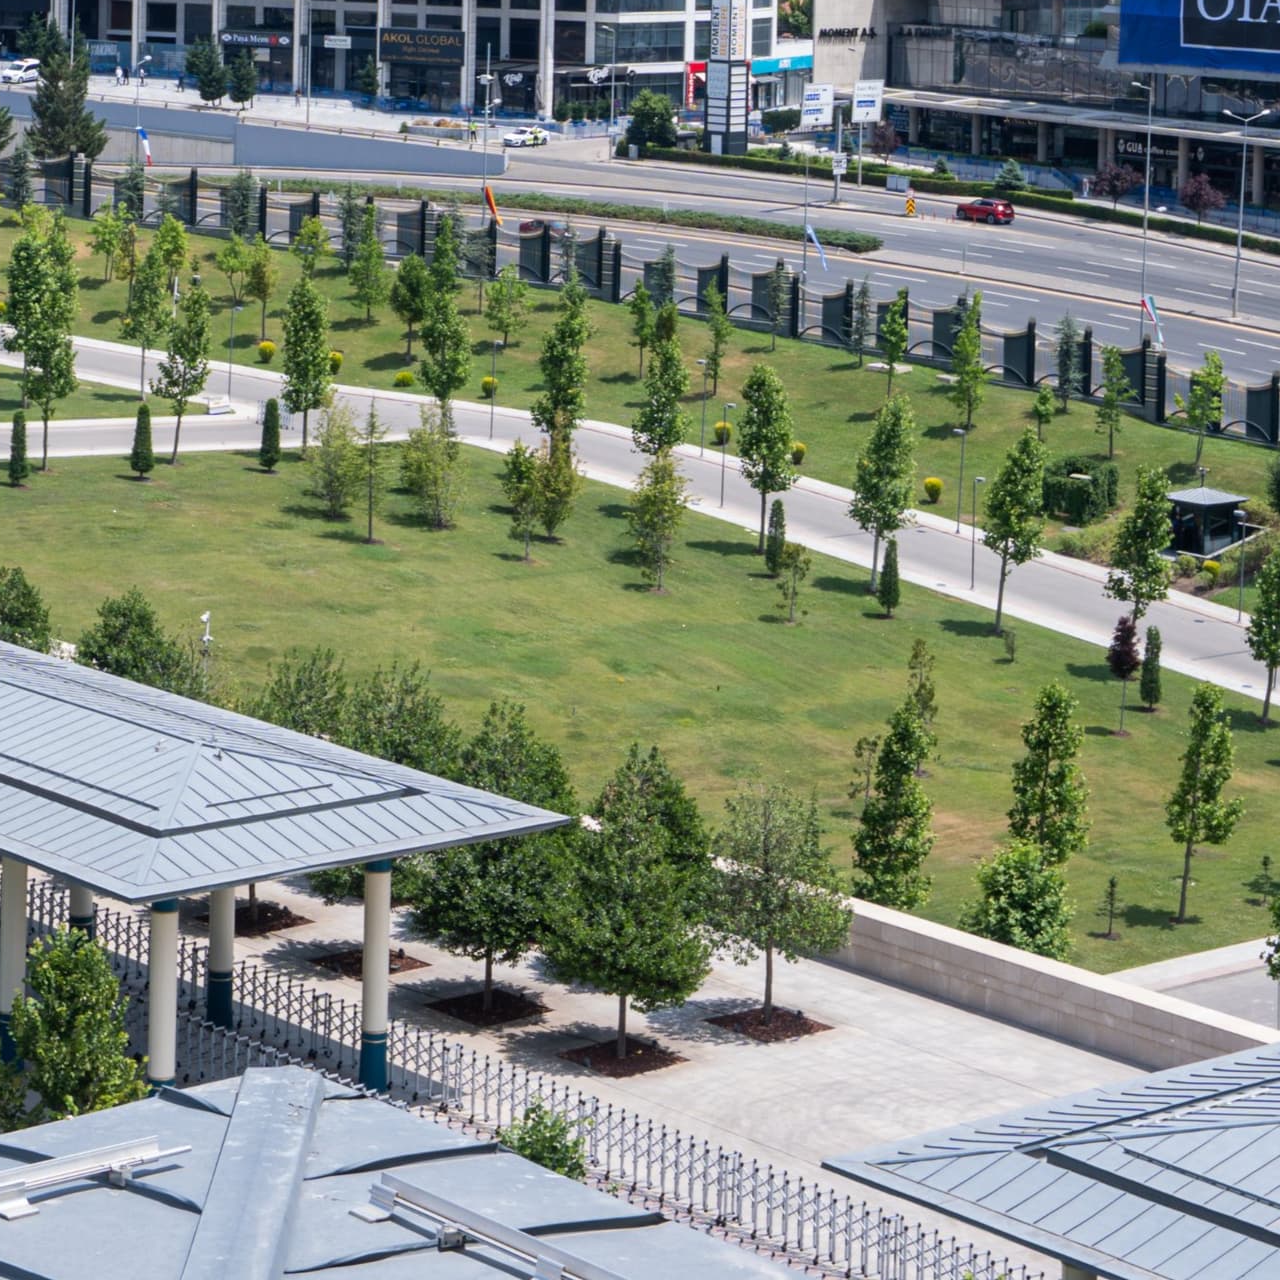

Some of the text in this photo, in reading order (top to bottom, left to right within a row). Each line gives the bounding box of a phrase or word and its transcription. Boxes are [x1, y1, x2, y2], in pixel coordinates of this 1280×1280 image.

[711, 6, 720, 56] MOMENT
[819, 27, 859, 38] MOMENT
[382, 32, 462, 47] AKOL GLOBAL
[1126, 141, 1143, 154] GUA
